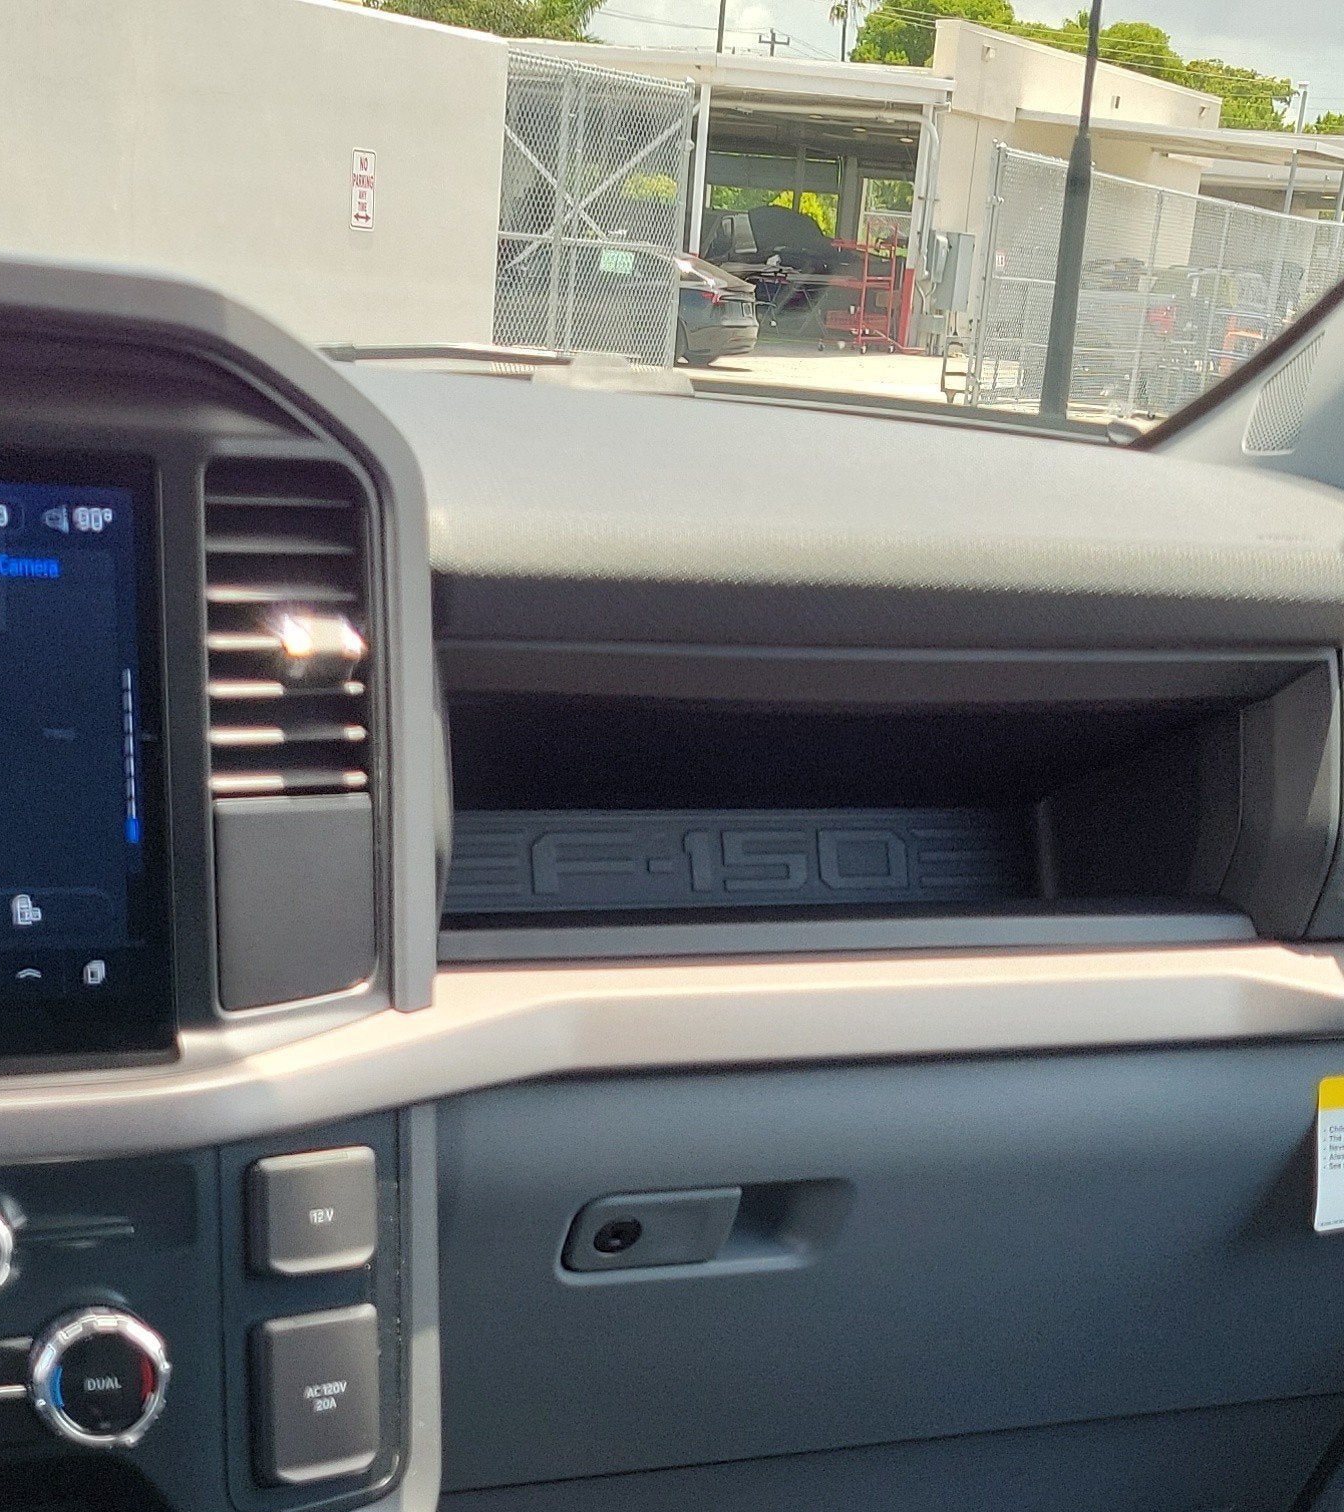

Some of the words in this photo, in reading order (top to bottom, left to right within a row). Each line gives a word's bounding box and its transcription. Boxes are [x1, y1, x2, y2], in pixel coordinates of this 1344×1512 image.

[531, 828, 908, 895] F-150
[83, 1376, 122, 1392] DUAL
[306, 1384, 321, 1399] AC
